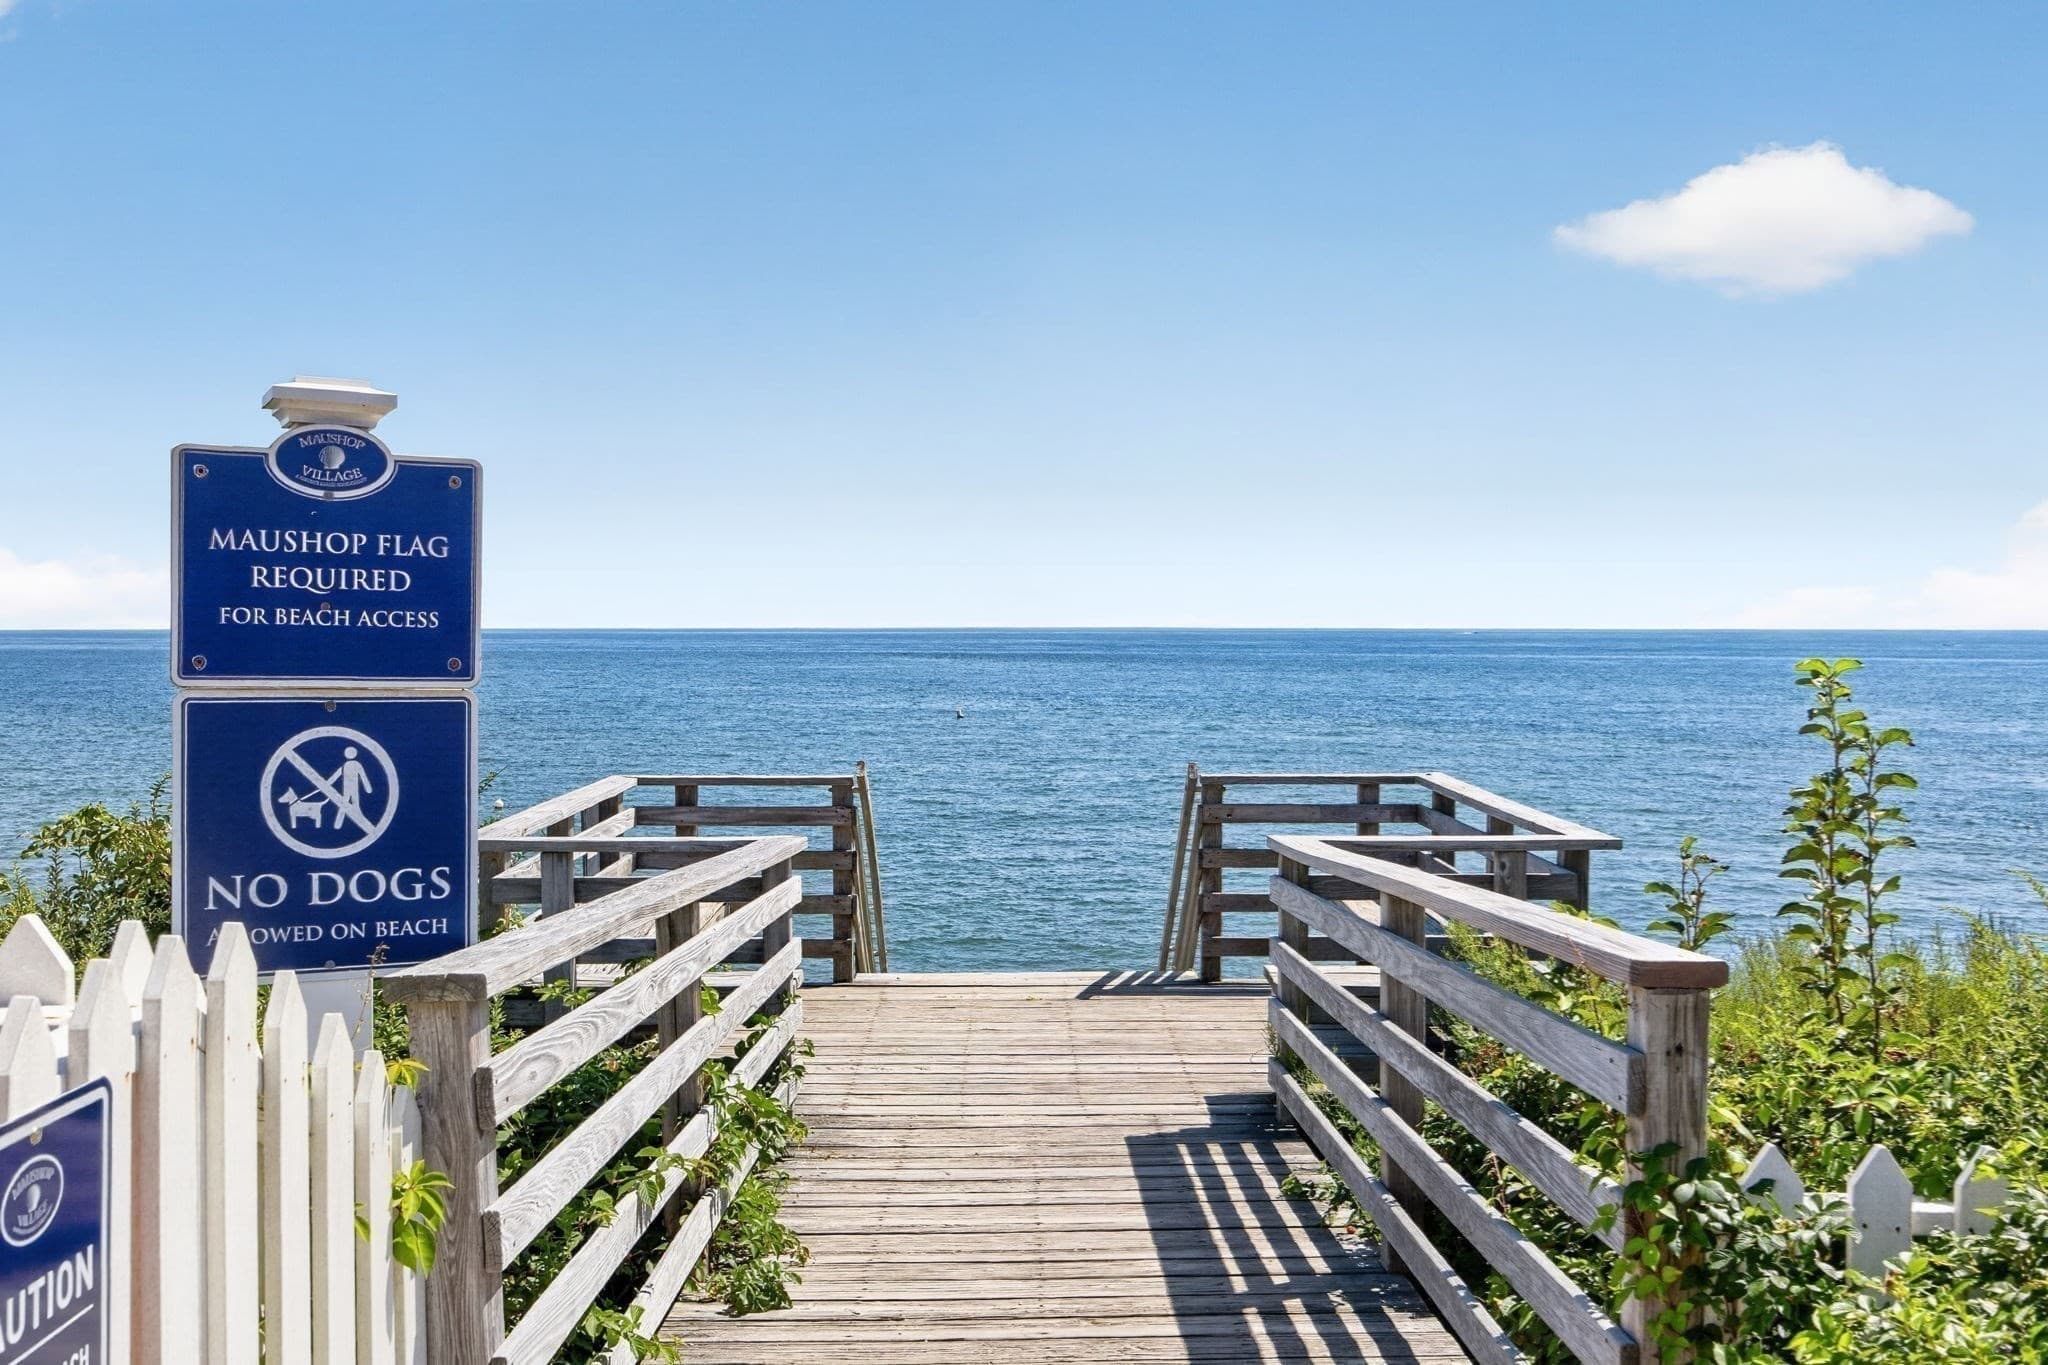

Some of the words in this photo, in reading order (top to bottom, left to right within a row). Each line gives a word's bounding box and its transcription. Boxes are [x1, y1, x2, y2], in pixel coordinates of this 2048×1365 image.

[300, 433, 366, 449] MAUSHOP
[303, 465, 363, 482] VILLAGE
[208, 528, 367, 555] MAUSHOP
[376, 534, 449, 558] FLAG
[250, 566, 411, 594] REQUIRED
[219, 607, 269, 625] FOR
[275, 608, 350, 627] BEACH
[357, 610, 439, 629] ACCESS
[204, 873, 288, 910] NO
[307, 866, 451, 906] DOGS
[205, 925, 323, 946] AOWED
[330, 922, 367, 940] ON
[375, 918, 448, 938] BEACH
[0, 1244, 94, 1354] UTION
